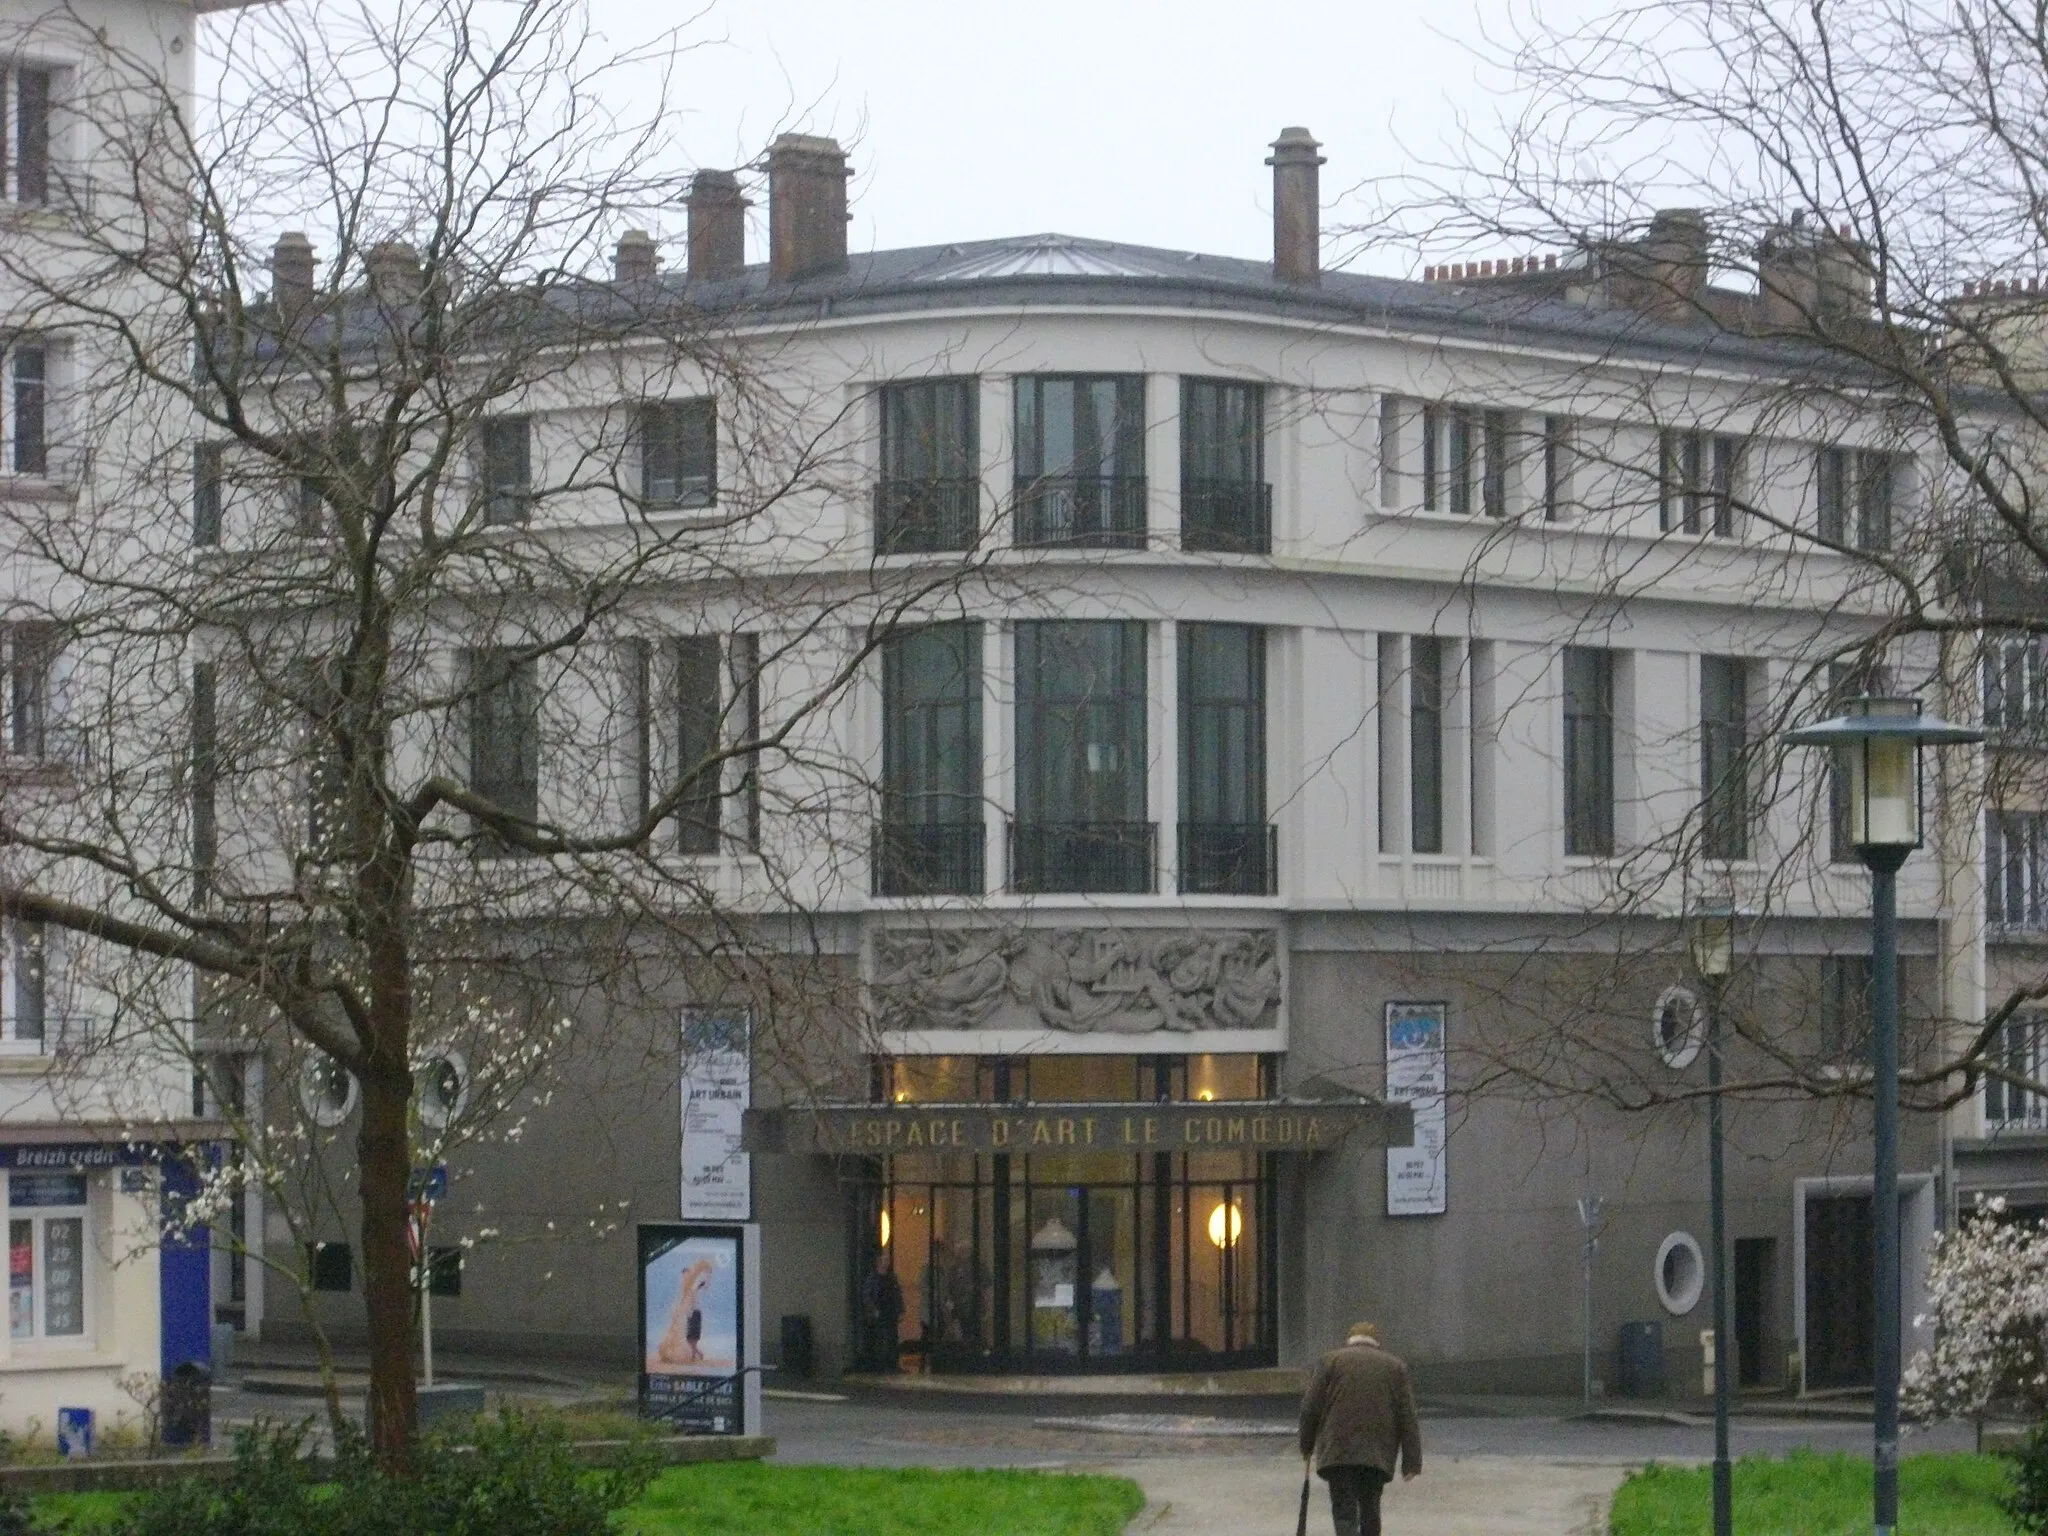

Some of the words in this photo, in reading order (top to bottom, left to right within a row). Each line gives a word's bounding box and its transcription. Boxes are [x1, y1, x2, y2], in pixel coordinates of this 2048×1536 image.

[850, 1119, 965, 1146] ESPACE
[1124, 1118, 1158, 1144] LE
[17, 1148, 66, 1166] Breizh
[51, 1224, 70, 1240] 02
